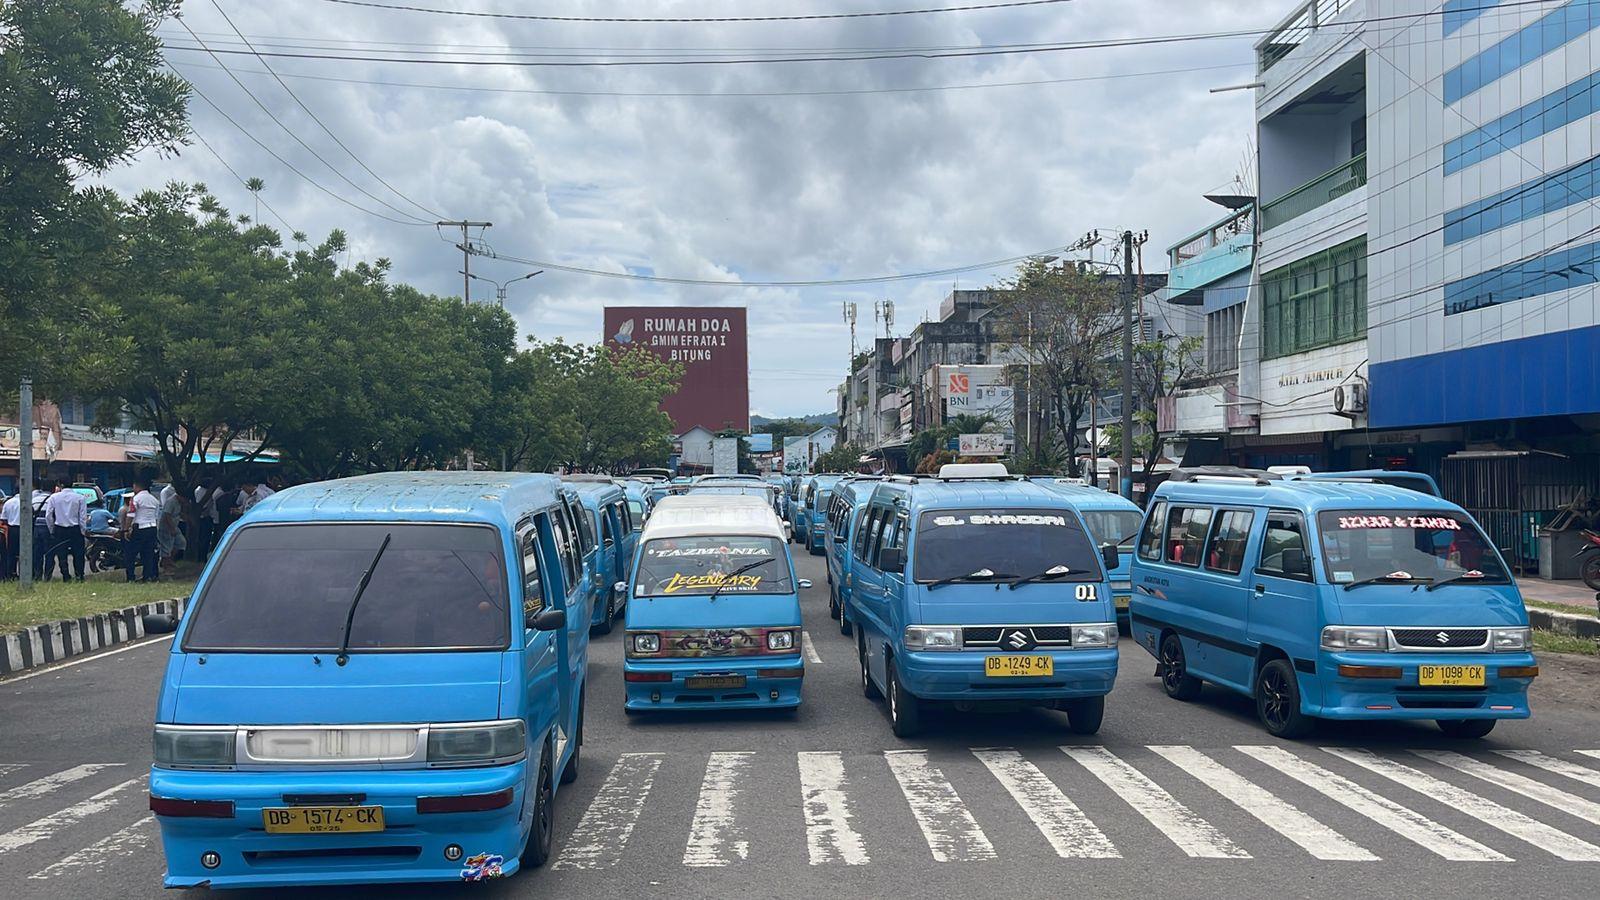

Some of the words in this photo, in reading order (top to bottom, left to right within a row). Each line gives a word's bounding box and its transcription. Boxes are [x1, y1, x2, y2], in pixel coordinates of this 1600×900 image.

[644, 318, 696, 332] RUMAH
[701, 318, 731, 332] DOA
[652, 335, 679, 346] GMIM
[681, 335, 718, 346] EFRATA
[671, 350, 711, 360] BITUNG
[950, 397, 969, 406] BNI
[656, 547, 771, 557] TAZMNIA
[1075, 584, 1098, 602] 01
[988, 657, 1001, 670] DB
[1008, 657, 1031, 669] 1249
[1037, 657, 1049, 669] CK
[1422, 666, 1434, 679] DB
[1441, 666, 1463, 678] 1098
[1469, 666, 1482, 679] CK
[269, 810, 290, 825] DB
[302, 809, 344, 825] 1574
[356, 808, 377, 823] CK
